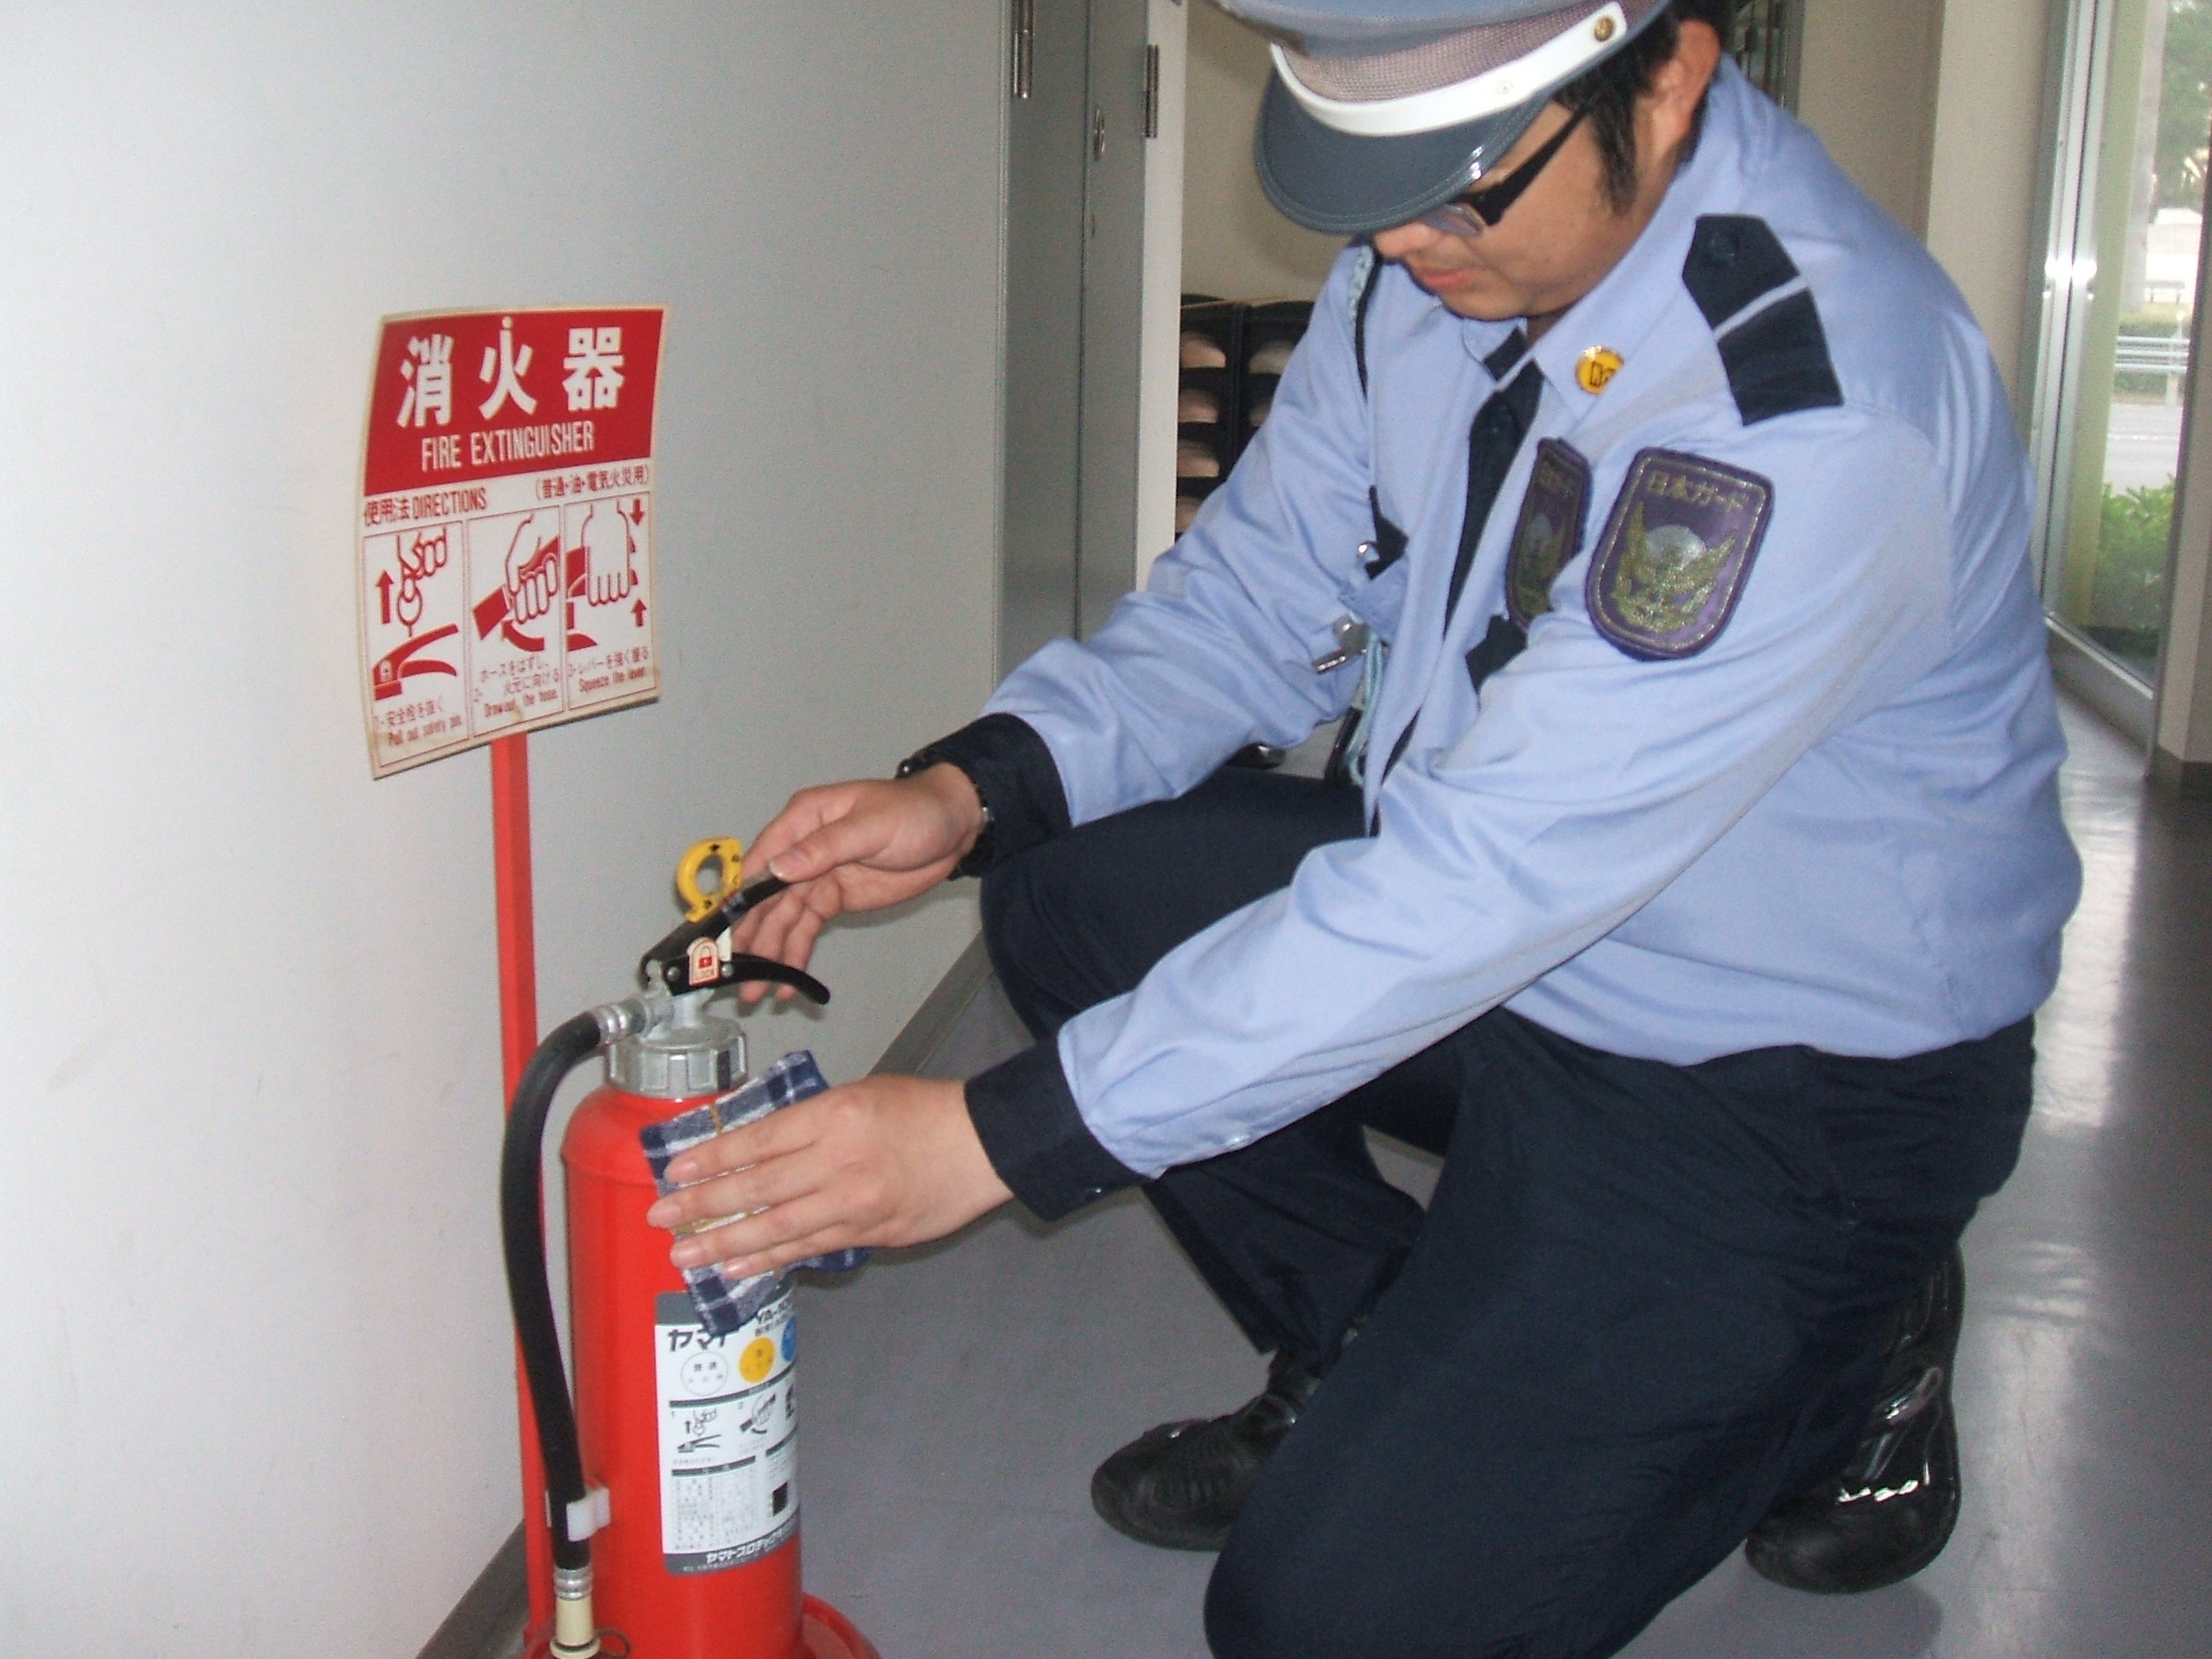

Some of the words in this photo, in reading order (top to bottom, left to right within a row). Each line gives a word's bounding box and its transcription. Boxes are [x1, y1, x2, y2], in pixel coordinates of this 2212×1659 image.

[396, 316, 626, 428] 消火器
[422, 434, 462, 472] FIRE
[470, 420, 595, 465] EXTINGUISHER
[364, 497, 410, 527] 使用法
[412, 486, 486, 520] DIRECTIONS
[522, 693, 536, 707] the
[667, 1327, 726, 1353] ヤマ
